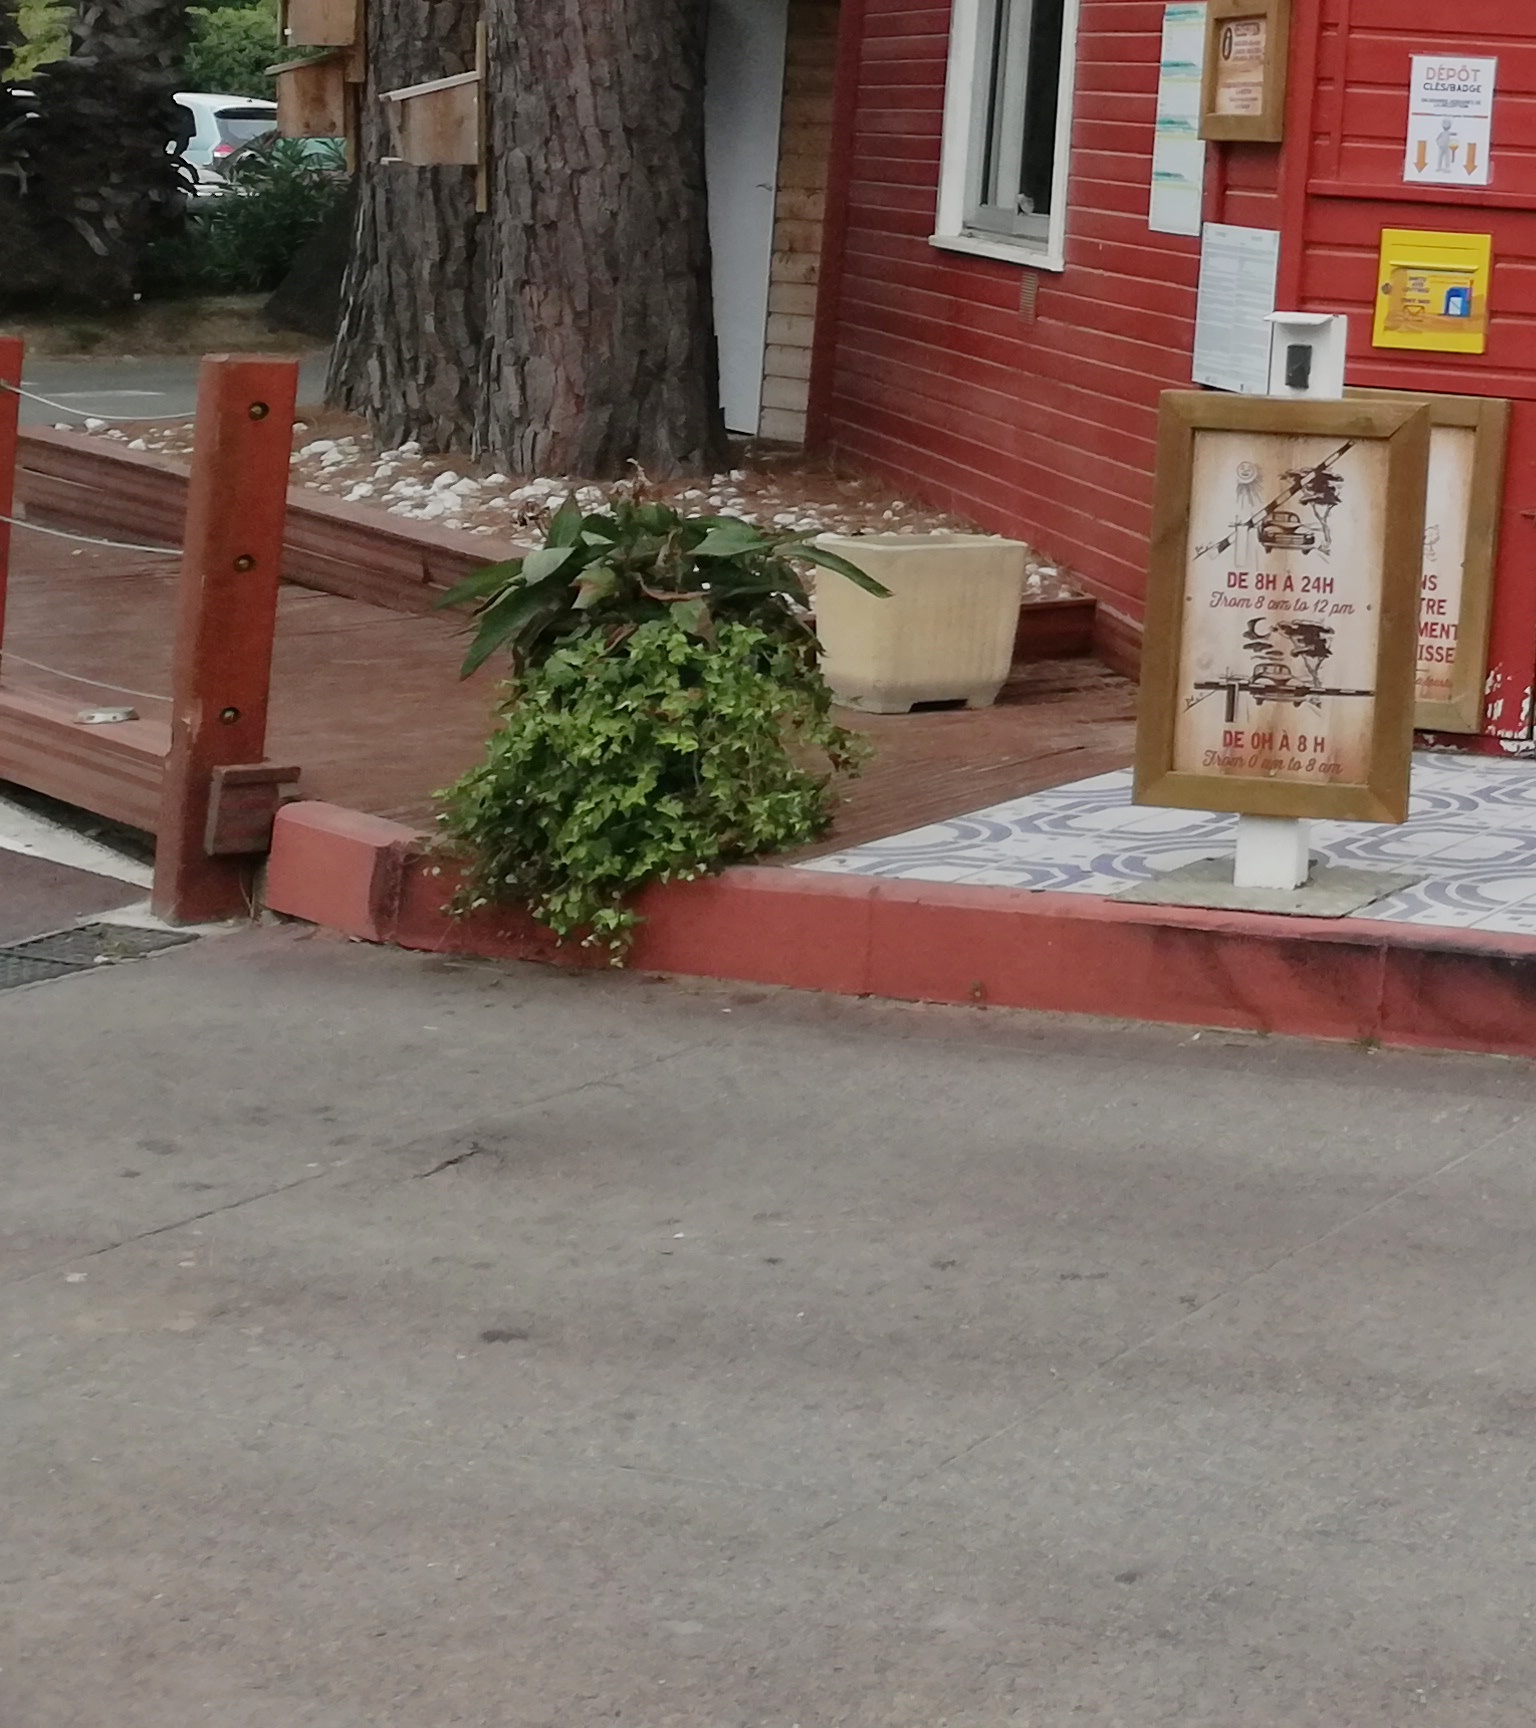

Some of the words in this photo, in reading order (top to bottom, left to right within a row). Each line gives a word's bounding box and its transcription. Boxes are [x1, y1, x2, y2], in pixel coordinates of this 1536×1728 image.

[1426, 64, 1481, 82] DÉPÔT
[1423, 81, 1482, 93] CLÉS/BADGE
[1227, 572, 1249, 589] DE
[1254, 573, 1277, 590] 8H
[1282, 570, 1294, 592] À
[1301, 575, 1334, 594] 24H
[1209, 591, 1252, 608] From
[1254, 595, 1265, 609] 8
[1267, 599, 1292, 611] am
[1293, 597, 1309, 612] to
[1313, 599, 1329, 614] 12
[1329, 605, 1355, 617] pm
[1223, 730, 1245, 748] DE
[1279, 729, 1291, 752] À
[1297, 735, 1307, 753] 8
[1313, 736, 1325, 753] H
[1202, 749, 1245, 767] From
[1287, 756, 1303, 771] to
[1305, 758, 1316, 772] 8
[1318, 762, 1343, 775] am
